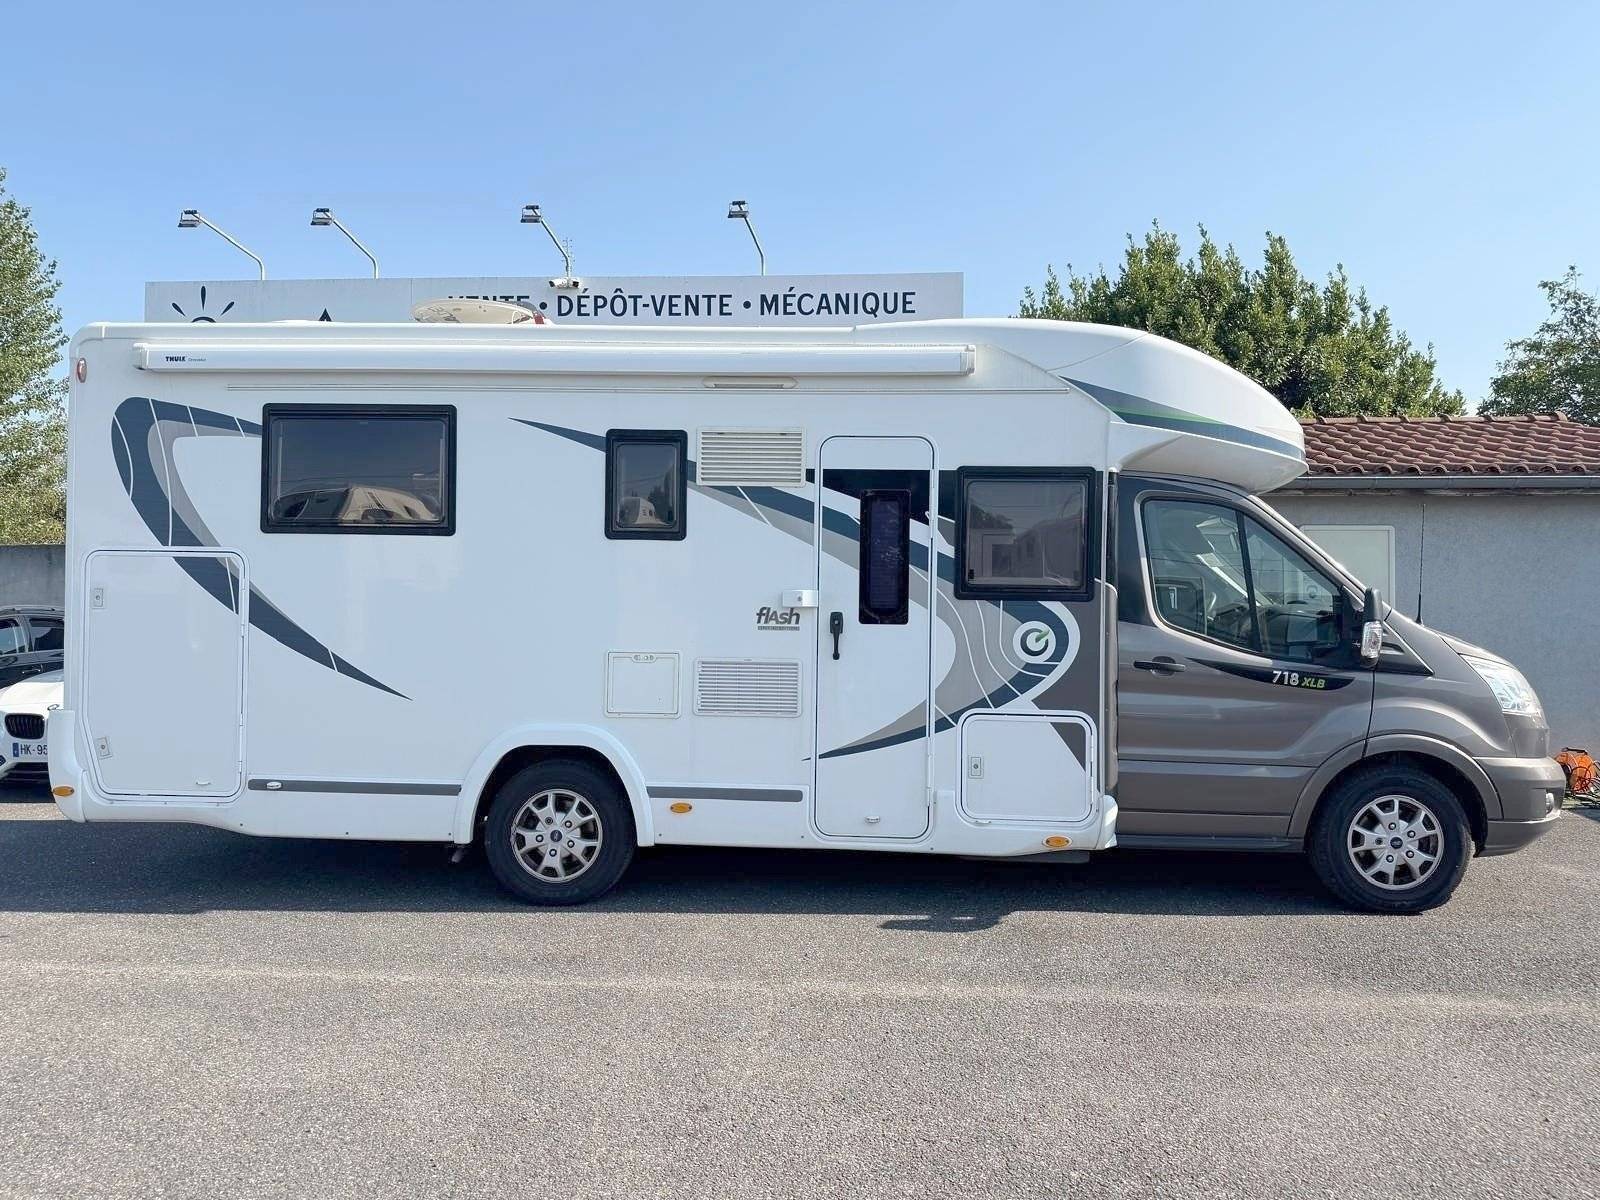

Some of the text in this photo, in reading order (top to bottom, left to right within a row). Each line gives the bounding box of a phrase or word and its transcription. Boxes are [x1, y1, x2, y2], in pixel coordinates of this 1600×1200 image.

[557, 286, 916, 318] DÉPÔT-VENTE MÉCANIQUE
[1272, 670, 1325, 688] 718 XLB
